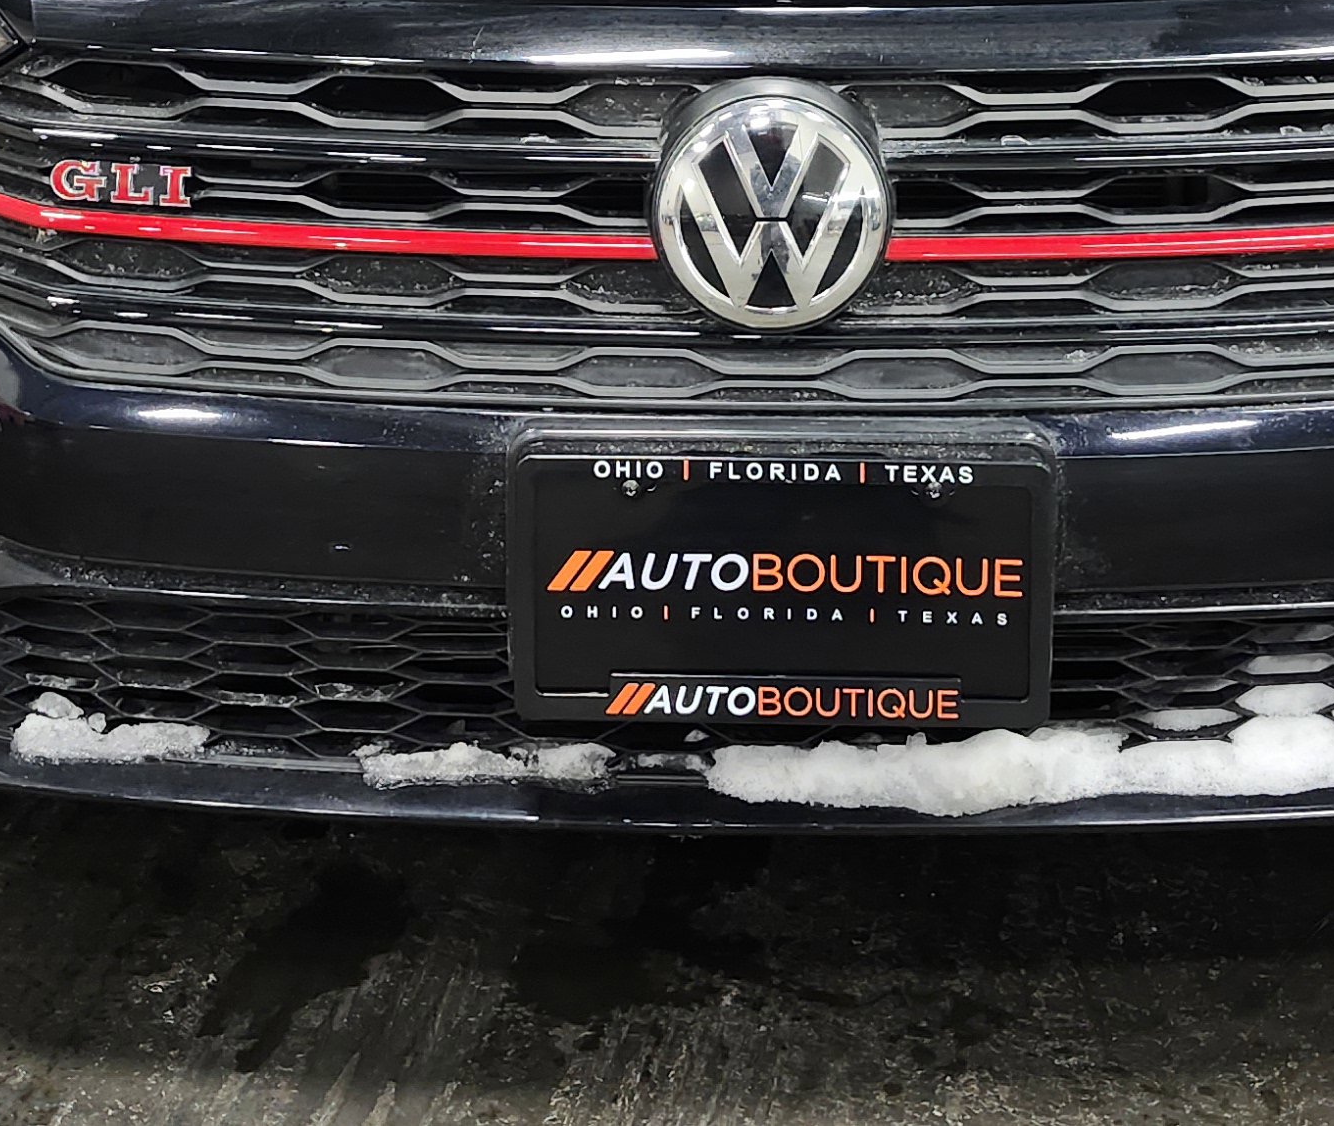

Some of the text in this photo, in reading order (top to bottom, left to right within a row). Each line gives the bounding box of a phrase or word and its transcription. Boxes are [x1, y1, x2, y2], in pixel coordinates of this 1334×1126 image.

[50, 159, 192, 208] GLI
[593, 460, 974, 484] OHIO FLORIDA TEXAS
[597, 552, 1024, 598] AUTOBOUTIQUE
[560, 605, 1008, 626] OHIO FLORIDA TEXAS
[643, 684, 960, 720] AUTOBOUTIQUE
